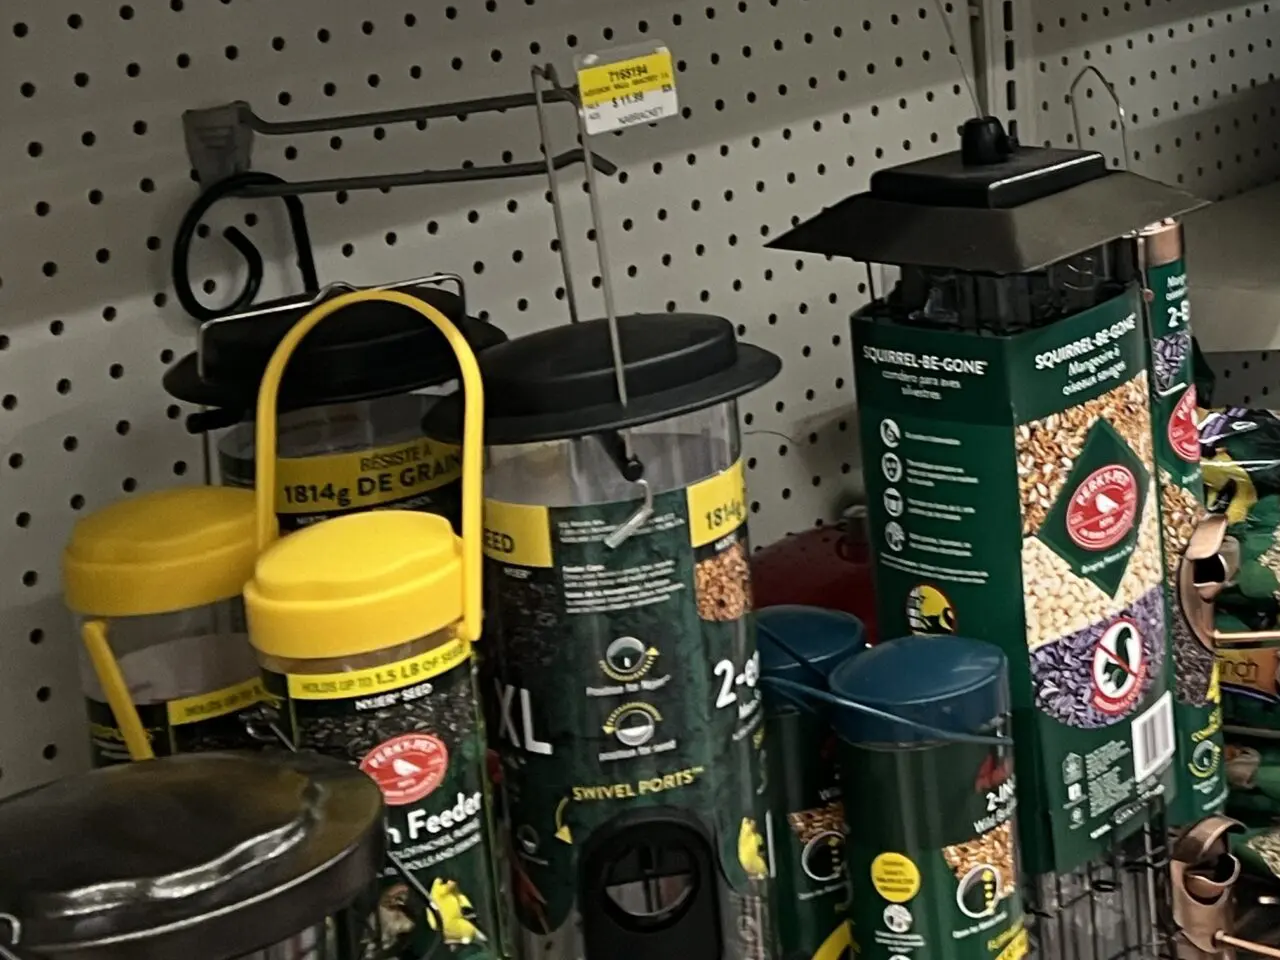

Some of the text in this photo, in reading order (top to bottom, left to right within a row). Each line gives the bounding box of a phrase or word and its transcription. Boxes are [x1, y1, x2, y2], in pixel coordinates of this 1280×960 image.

[284, 483, 352, 507] 1814g
[357, 473, 392, 496] DE
[1076, 471, 1130, 505] PERKY-PET
[375, 670, 398, 685] 1.5
[400, 662, 420, 678] LB
[422, 654, 438, 671] OF
[401, 682, 433, 701] SEED
[572, 784, 636, 801] SWIVEL
[407, 791, 482, 839] Feeder
